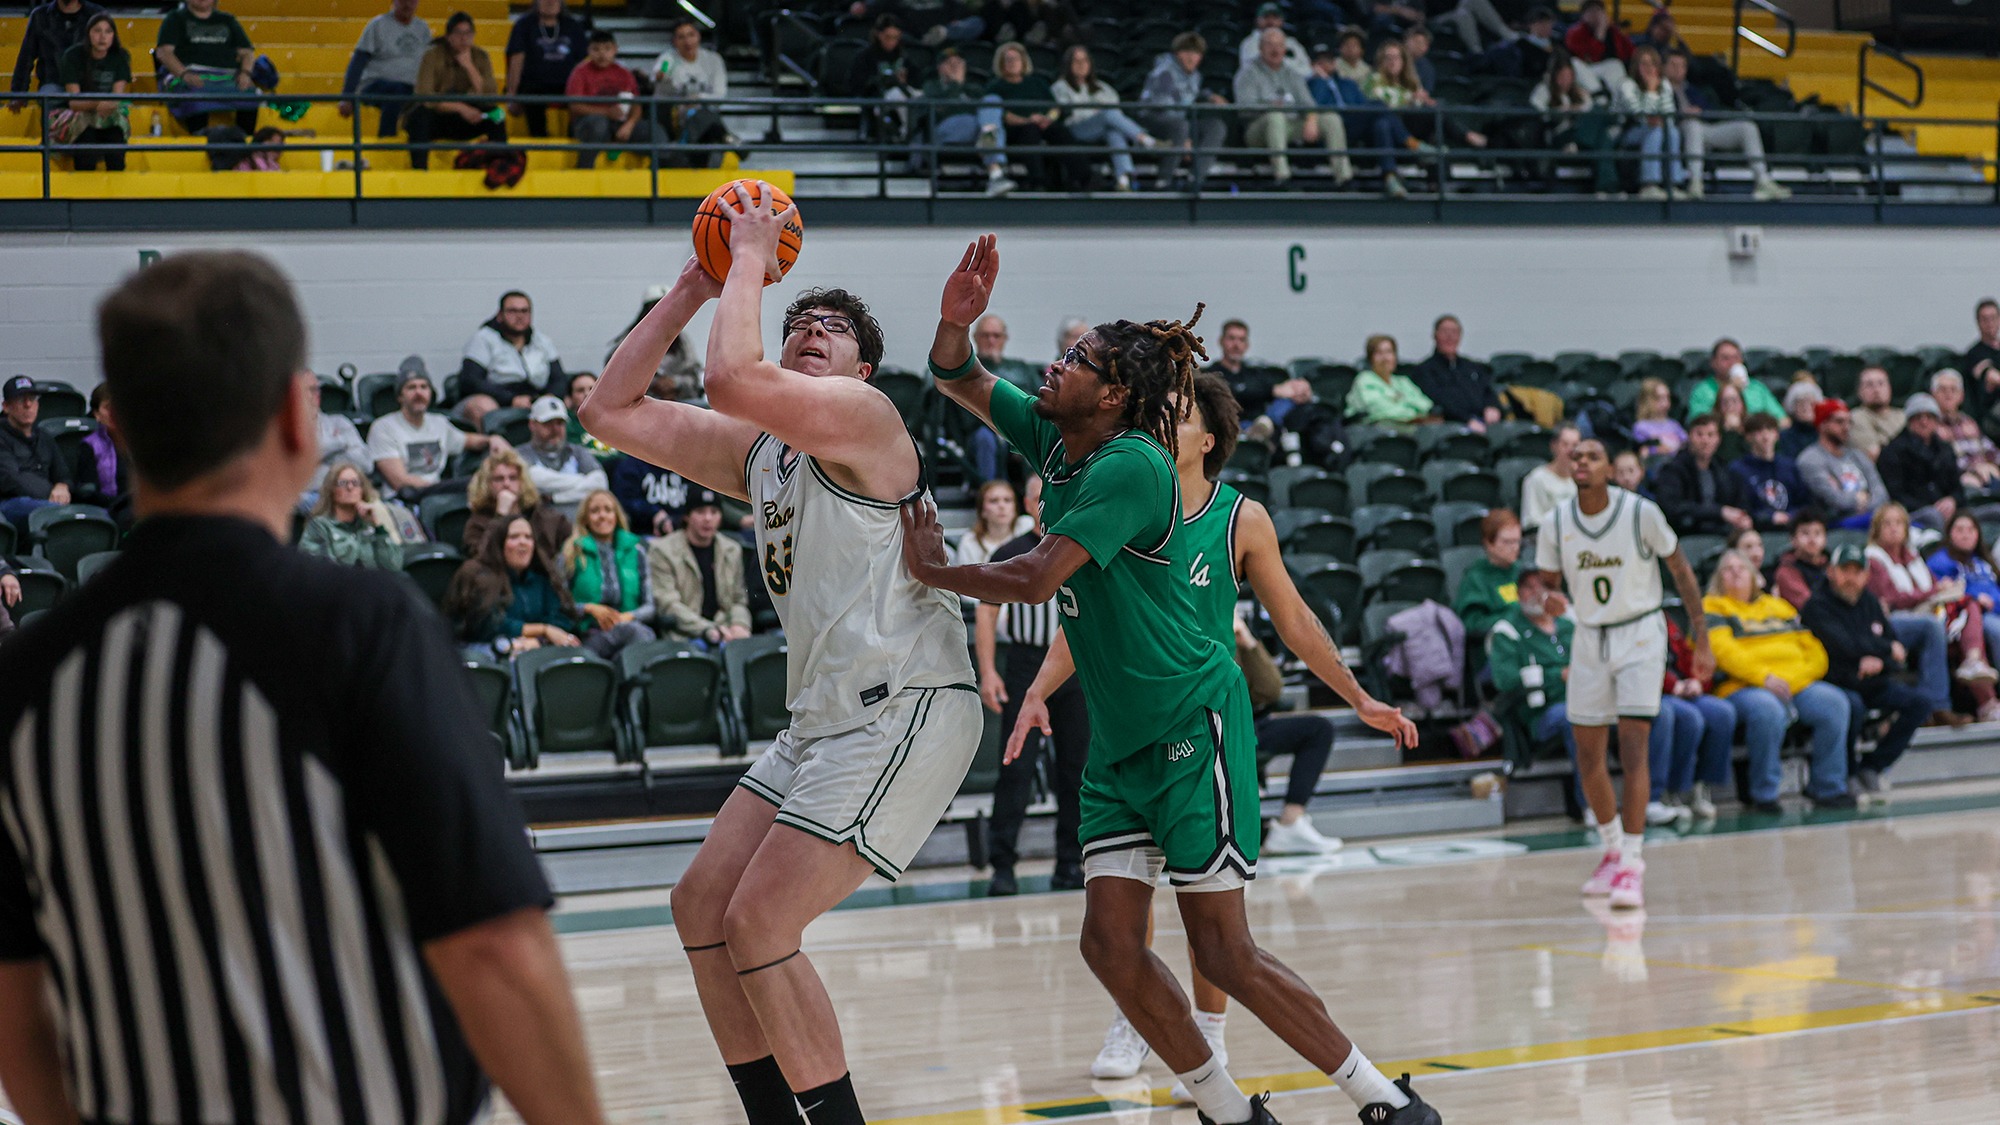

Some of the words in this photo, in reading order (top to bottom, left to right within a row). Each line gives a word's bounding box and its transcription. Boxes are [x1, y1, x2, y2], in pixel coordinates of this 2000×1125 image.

[1287, 245, 1306, 293] C
[1577, 550, 1623, 571] Bison
[1593, 575, 1612, 605] 0
